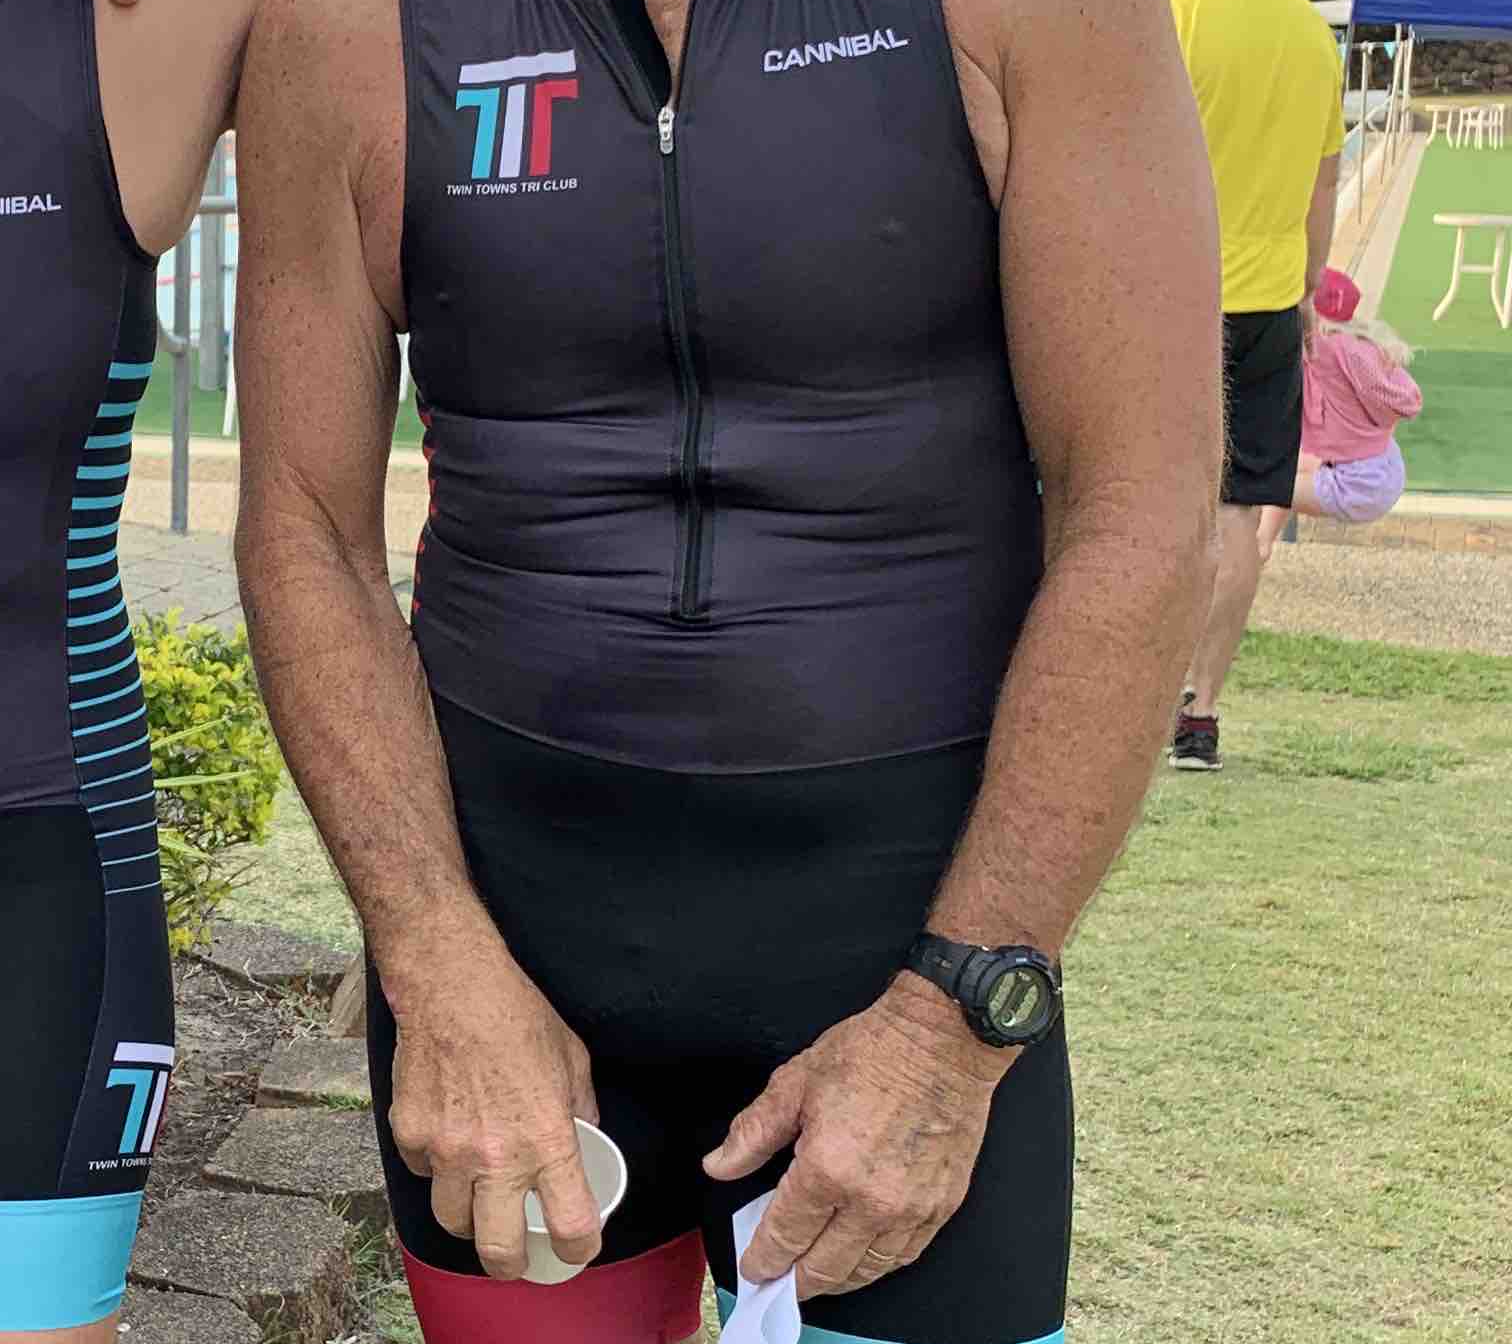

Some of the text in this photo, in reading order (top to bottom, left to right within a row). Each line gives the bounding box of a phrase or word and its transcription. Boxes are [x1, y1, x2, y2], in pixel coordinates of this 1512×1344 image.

[762, 27, 909, 74] CANNIBAL
[447, 177, 578, 196] TWIN TOWNS TRI CLUB
[88, 1159, 118, 1171] TWIN
